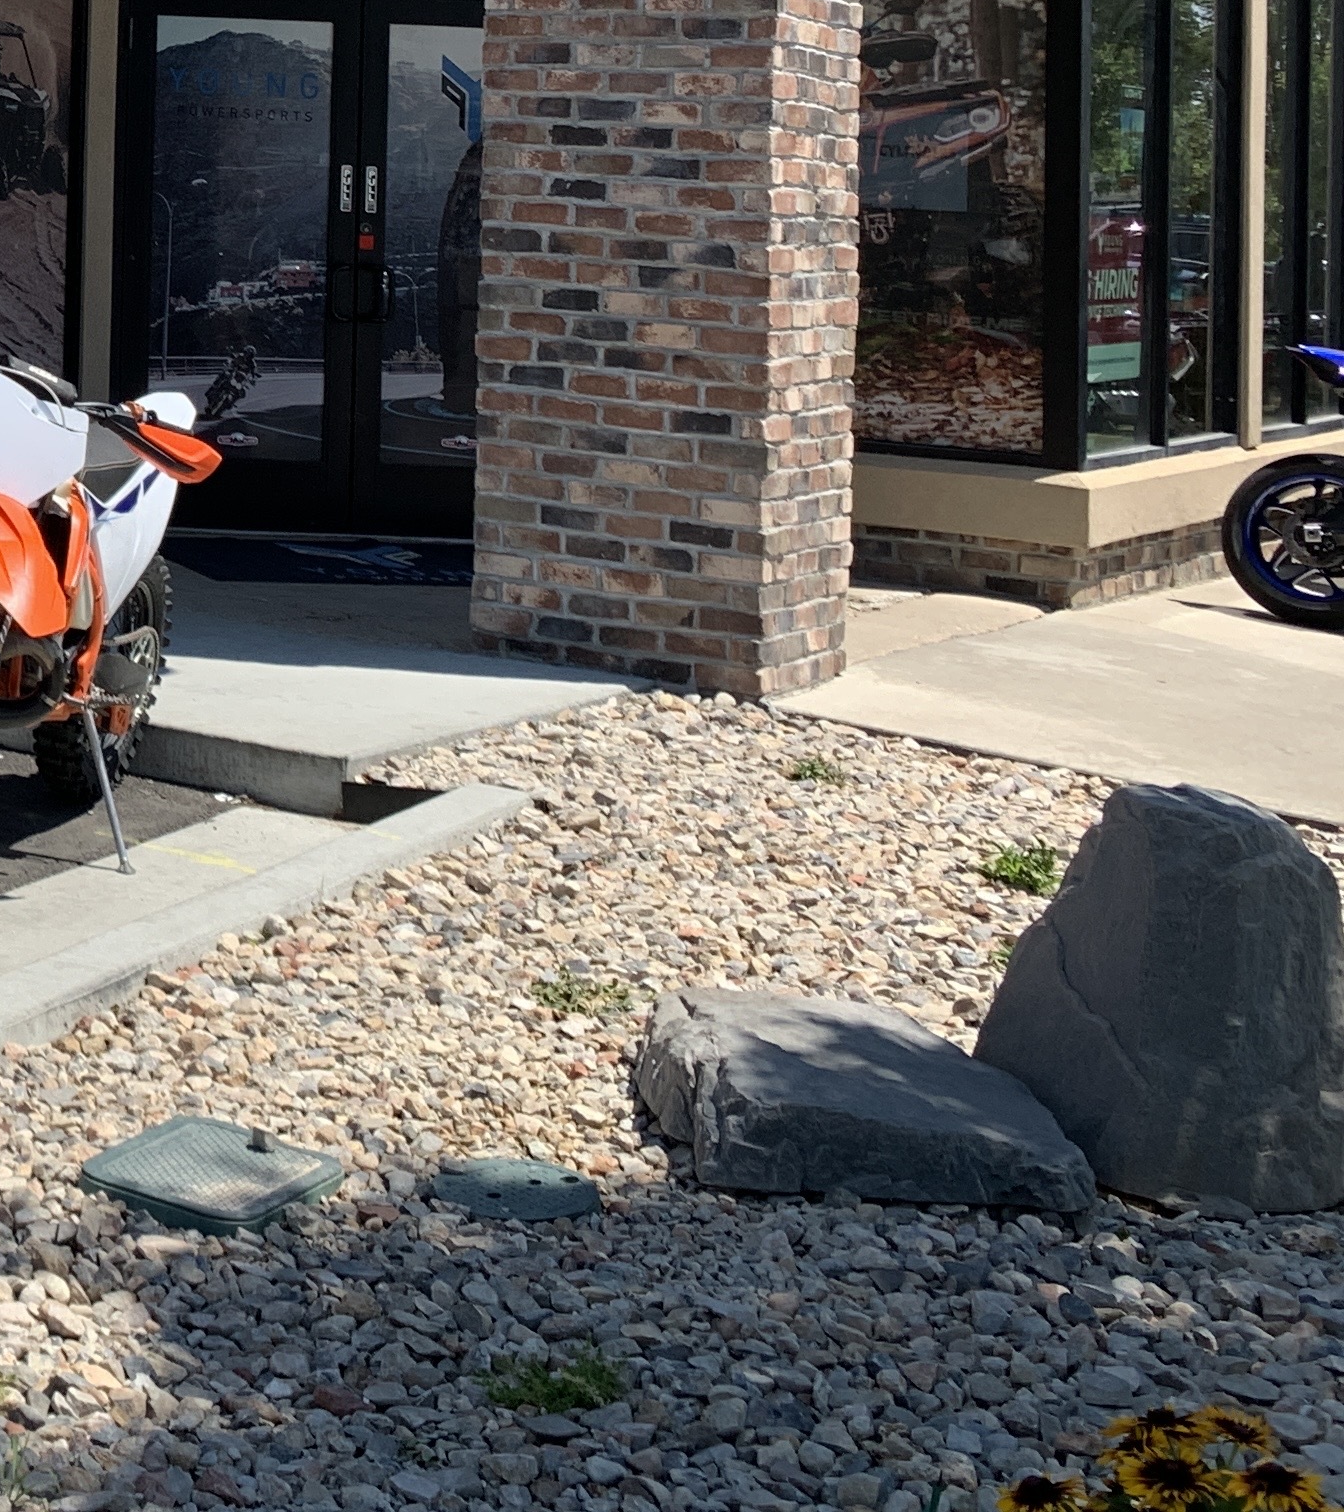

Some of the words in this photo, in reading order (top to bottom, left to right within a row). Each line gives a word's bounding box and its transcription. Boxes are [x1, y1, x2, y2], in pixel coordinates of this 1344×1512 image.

[168, 67, 320, 100] YOUNG
[176, 103, 314, 123] POWERSPORTS
[343, 169, 351, 202] PULL
[367, 170, 376, 203] PULL
[1095, 267, 1139, 301] HIRING
